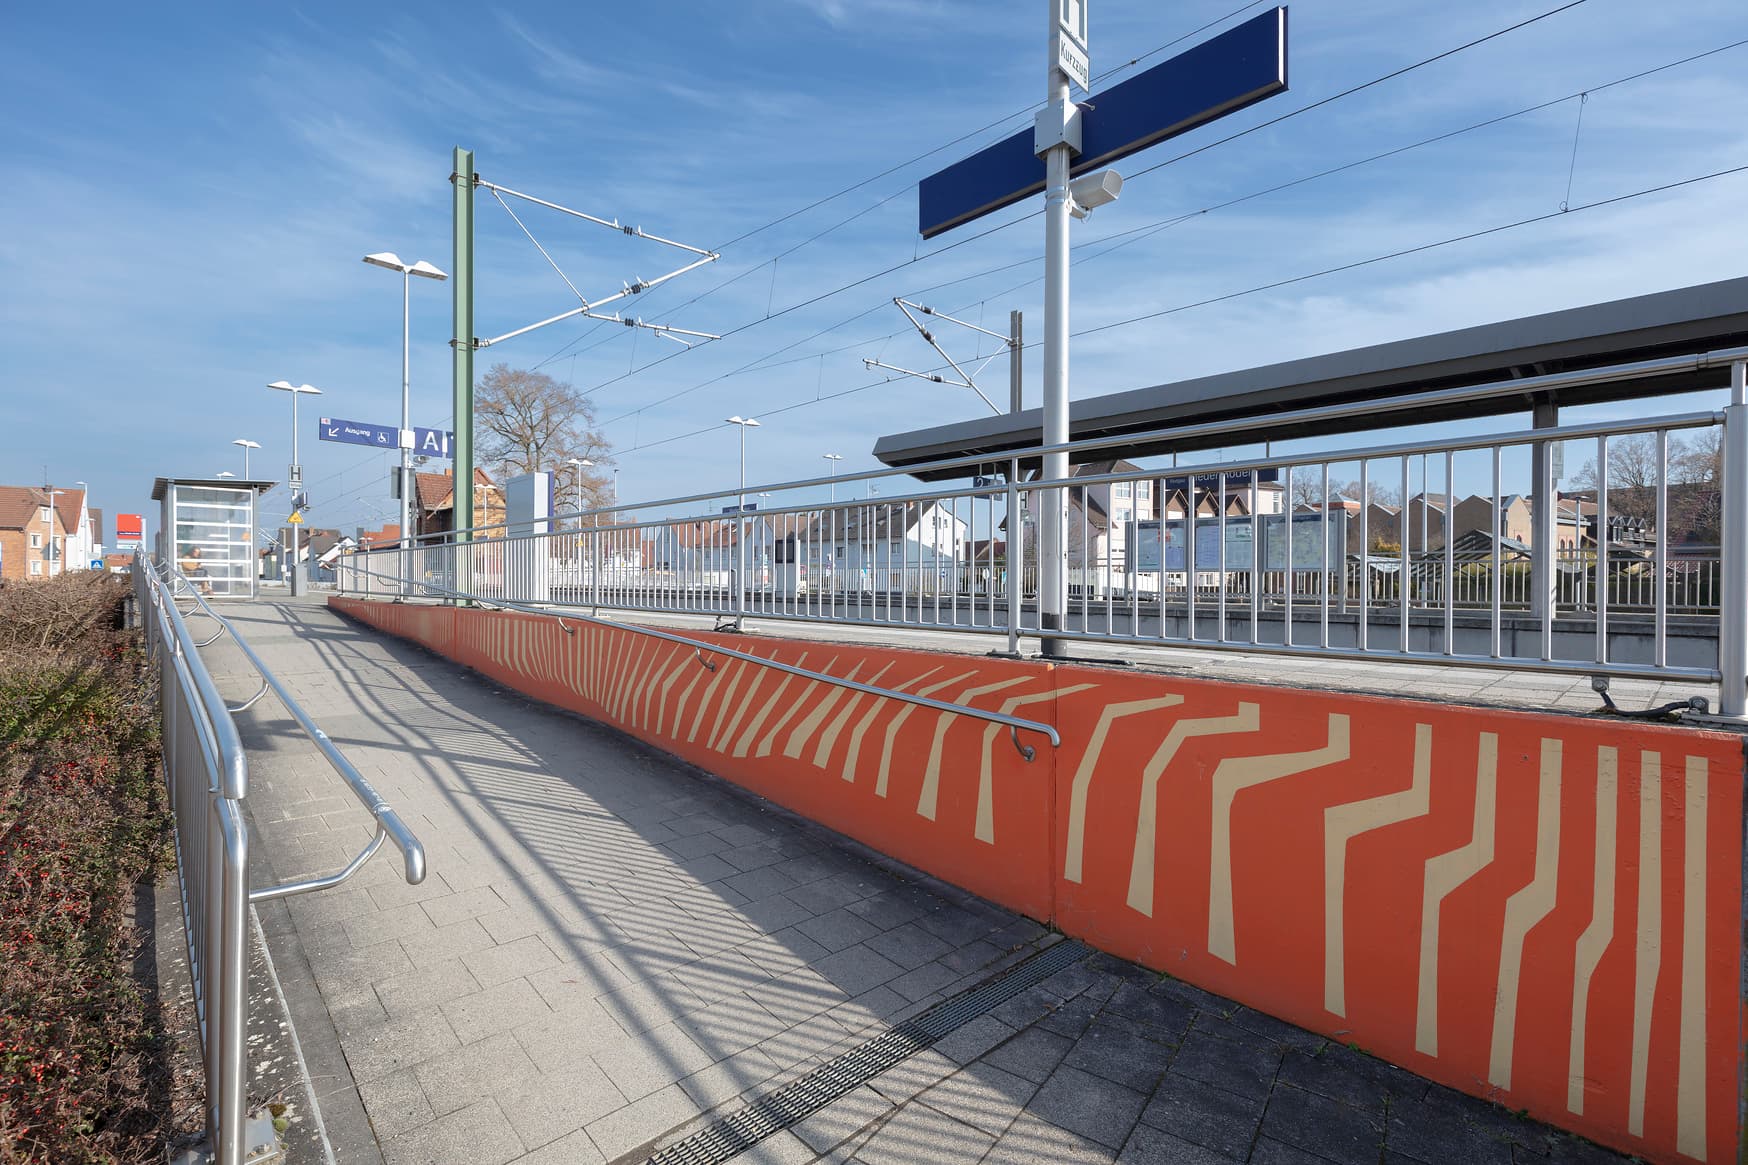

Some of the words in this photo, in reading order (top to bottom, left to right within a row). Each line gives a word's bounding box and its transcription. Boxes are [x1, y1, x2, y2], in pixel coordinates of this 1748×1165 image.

[345, 427, 371, 437] Ausgang
[422, 431, 439, 451] A
[290, 466, 301, 480] H
